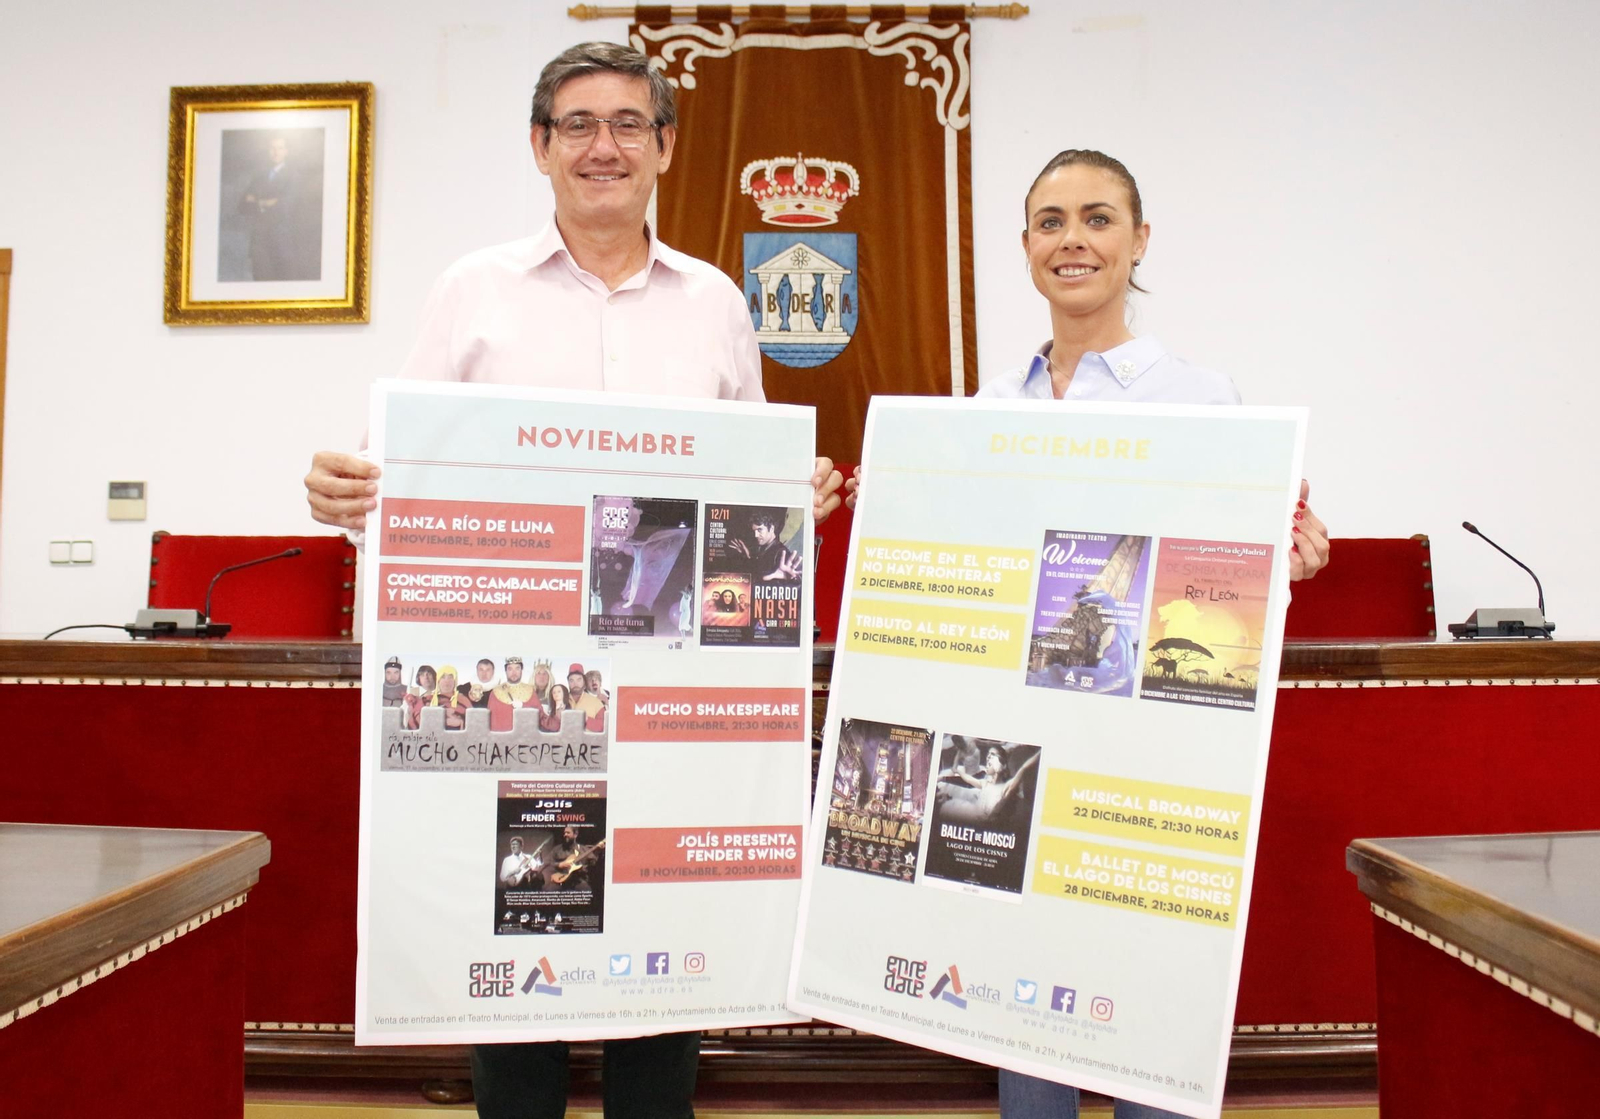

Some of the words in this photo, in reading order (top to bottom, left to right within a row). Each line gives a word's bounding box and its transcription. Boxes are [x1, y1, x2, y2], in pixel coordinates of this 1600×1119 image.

[518, 426, 695, 456] NOVIEMBRE
[990, 433, 1152, 460] DICIEMBRE
[711, 508, 730, 520] 12/11
[389, 516, 446, 530] DANZA
[452, 515, 480, 531] RÍO
[486, 520, 506, 532] DE
[511, 520, 554, 534] LUNA
[388, 534, 397, 543] 11
[400, 534, 473, 547] NOVIEMBRE,
[477, 537, 507, 548] 18:00
[510, 538, 551, 548] HORAS
[865, 547, 932, 564] WELCOME
[938, 552, 957, 566] EN
[964, 554, 978, 567] EL
[987, 556, 1030, 570] CIELO
[1042, 540, 1108, 566] Welcome
[862, 561, 883, 573] NO
[887, 563, 914, 576] HAY
[918, 565, 1002, 583] FRONTERAS
[387, 574, 472, 588] CONCIERTO
[476, 576, 578, 592] CAMBALACHE
[860, 578, 867, 586] 2
[870, 578, 925, 592] DICIEMBRE,
[928, 584, 954, 594] 18:00
[957, 586, 994, 597] HORAS
[387, 588, 398, 600] Y
[401, 590, 468, 602] RICARDO
[472, 592, 512, 604] NASH
[754, 586, 798, 600] RICARDO
[386, 606, 398, 616] 12
[401, 607, 474, 620] NOVIEMBRE,
[478, 610, 508, 620] 19:00
[512, 610, 552, 620] HORAS
[754, 600, 796, 619] NASH
[626, 618, 644, 626] luna
[856, 614, 912, 632] TRIBUTO
[916, 620, 935, 634] AL
[939, 623, 967, 638] REY
[971, 625, 1010, 641] LEÓN
[853, 632, 860, 640] 9
[862, 632, 917, 648] DICIEMBRE,
[920, 639, 947, 649] 17:00
[950, 642, 987, 654] HORAS
[634, 703, 692, 716] MUCHO
[696, 704, 800, 716] SHAKESPEARE
[648, 721, 658, 730] 17
[661, 721, 728, 731] NOVIEMBRE,
[732, 721, 758, 730] 21:30
[762, 721, 798, 730] HORAS
[388, 742, 458, 764] MUCHO
[467, 743, 602, 766] SHAKESPEARE
[536, 800, 572, 808] Jolís
[1071, 788, 1143, 811] MUSICAL
[1149, 798, 1241, 824] BROADWAY
[829, 810, 921, 842] BROADWAY
[1073, 807, 1088, 817] 22
[1091, 810, 1157, 829] DICIEMBRE,
[1161, 820, 1192, 833] 21:30
[1195, 826, 1239, 840] HORAS
[676, 832, 719, 848] JOLÍS
[724, 834, 796, 846] PRESENTA
[941, 824, 975, 842] BALLET
[975, 833, 982, 841] DE
[982, 831, 1015, 849] MOSCÚ
[686, 848, 742, 862] FENDER
[748, 848, 796, 860] SWING
[986, 849, 1008, 858] CISNES
[640, 868, 650, 878] 18
[654, 867, 722, 877] NOVIEMBRE,
[726, 866, 756, 876] 20:30
[758, 864, 796, 874] HORAS
[1081, 852, 1140, 873] BALLET
[1146, 863, 1167, 878] DE
[1171, 868, 1234, 890] MOSCÚ
[1043, 862, 1060, 876] EL
[1064, 865, 1110, 884] LAGO
[1114, 874, 1134, 889] DE
[1138, 878, 1169, 895] LOS
[1173, 884, 1232, 906] CISNES
[1064, 884, 1078, 894] 28
[1081, 886, 1147, 908] DICIEMBRE,
[1152, 900, 1182, 914] 21:30
[1186, 906, 1229, 922] HORAS
[560, 966, 596, 982] adra
[966, 982, 1000, 1001] adra
[375, 1016, 397, 1025] Venta
[398, 1016, 408, 1024] de
[411, 1015, 445, 1024] entradas
[458, 1014, 466, 1022] el
[468, 1014, 492, 1022] Teatro
[494, 1013, 532, 1023] Municipal,
[534, 1013, 543, 1021] de
[546, 1012, 568, 1021] Lunes
[577, 1010, 605, 1020] Viernes
[607, 1010, 616, 1019] de
[619, 1009, 634, 1018] 16h.
[643, 1008, 659, 1017] 21h.
[667, 1006, 715, 1017] Ayuntamiento
[718, 1006, 726, 1014] de
[728, 1005, 745, 1014] Adra
[747, 1004, 756, 1013] de
[758, 1004, 768, 1012] 9h.
[803, 987, 821, 999] Venta
[822, 991, 830, 1001] de
[832, 994, 859, 1009] entradas
[862, 1002, 870, 1010] en
[871, 1003, 878, 1012] el
[879, 1006, 899, 1018] Teatro
[901, 1012, 935, 1028] Municipal,
[937, 1020, 946, 1030] de
[948, 1024, 969, 1036] Lunes
[978, 1031, 1004, 1044] Viernes
[1006, 1037, 1015, 1048] de
[1018, 1040, 1032, 1052] 16h.
[1042, 1046, 1057, 1058] 21h.
[1060, 1052, 1064, 1061] y
[1066, 1052, 1118, 1073] Ayuntamiento
[1120, 1065, 1130, 1076] de
[1132, 1068, 1151, 1081] Adra
[1152, 1074, 1163, 1084] de
[1165, 1076, 1177, 1087] 9h.
[1188, 1081, 1205, 1094] 14h.
